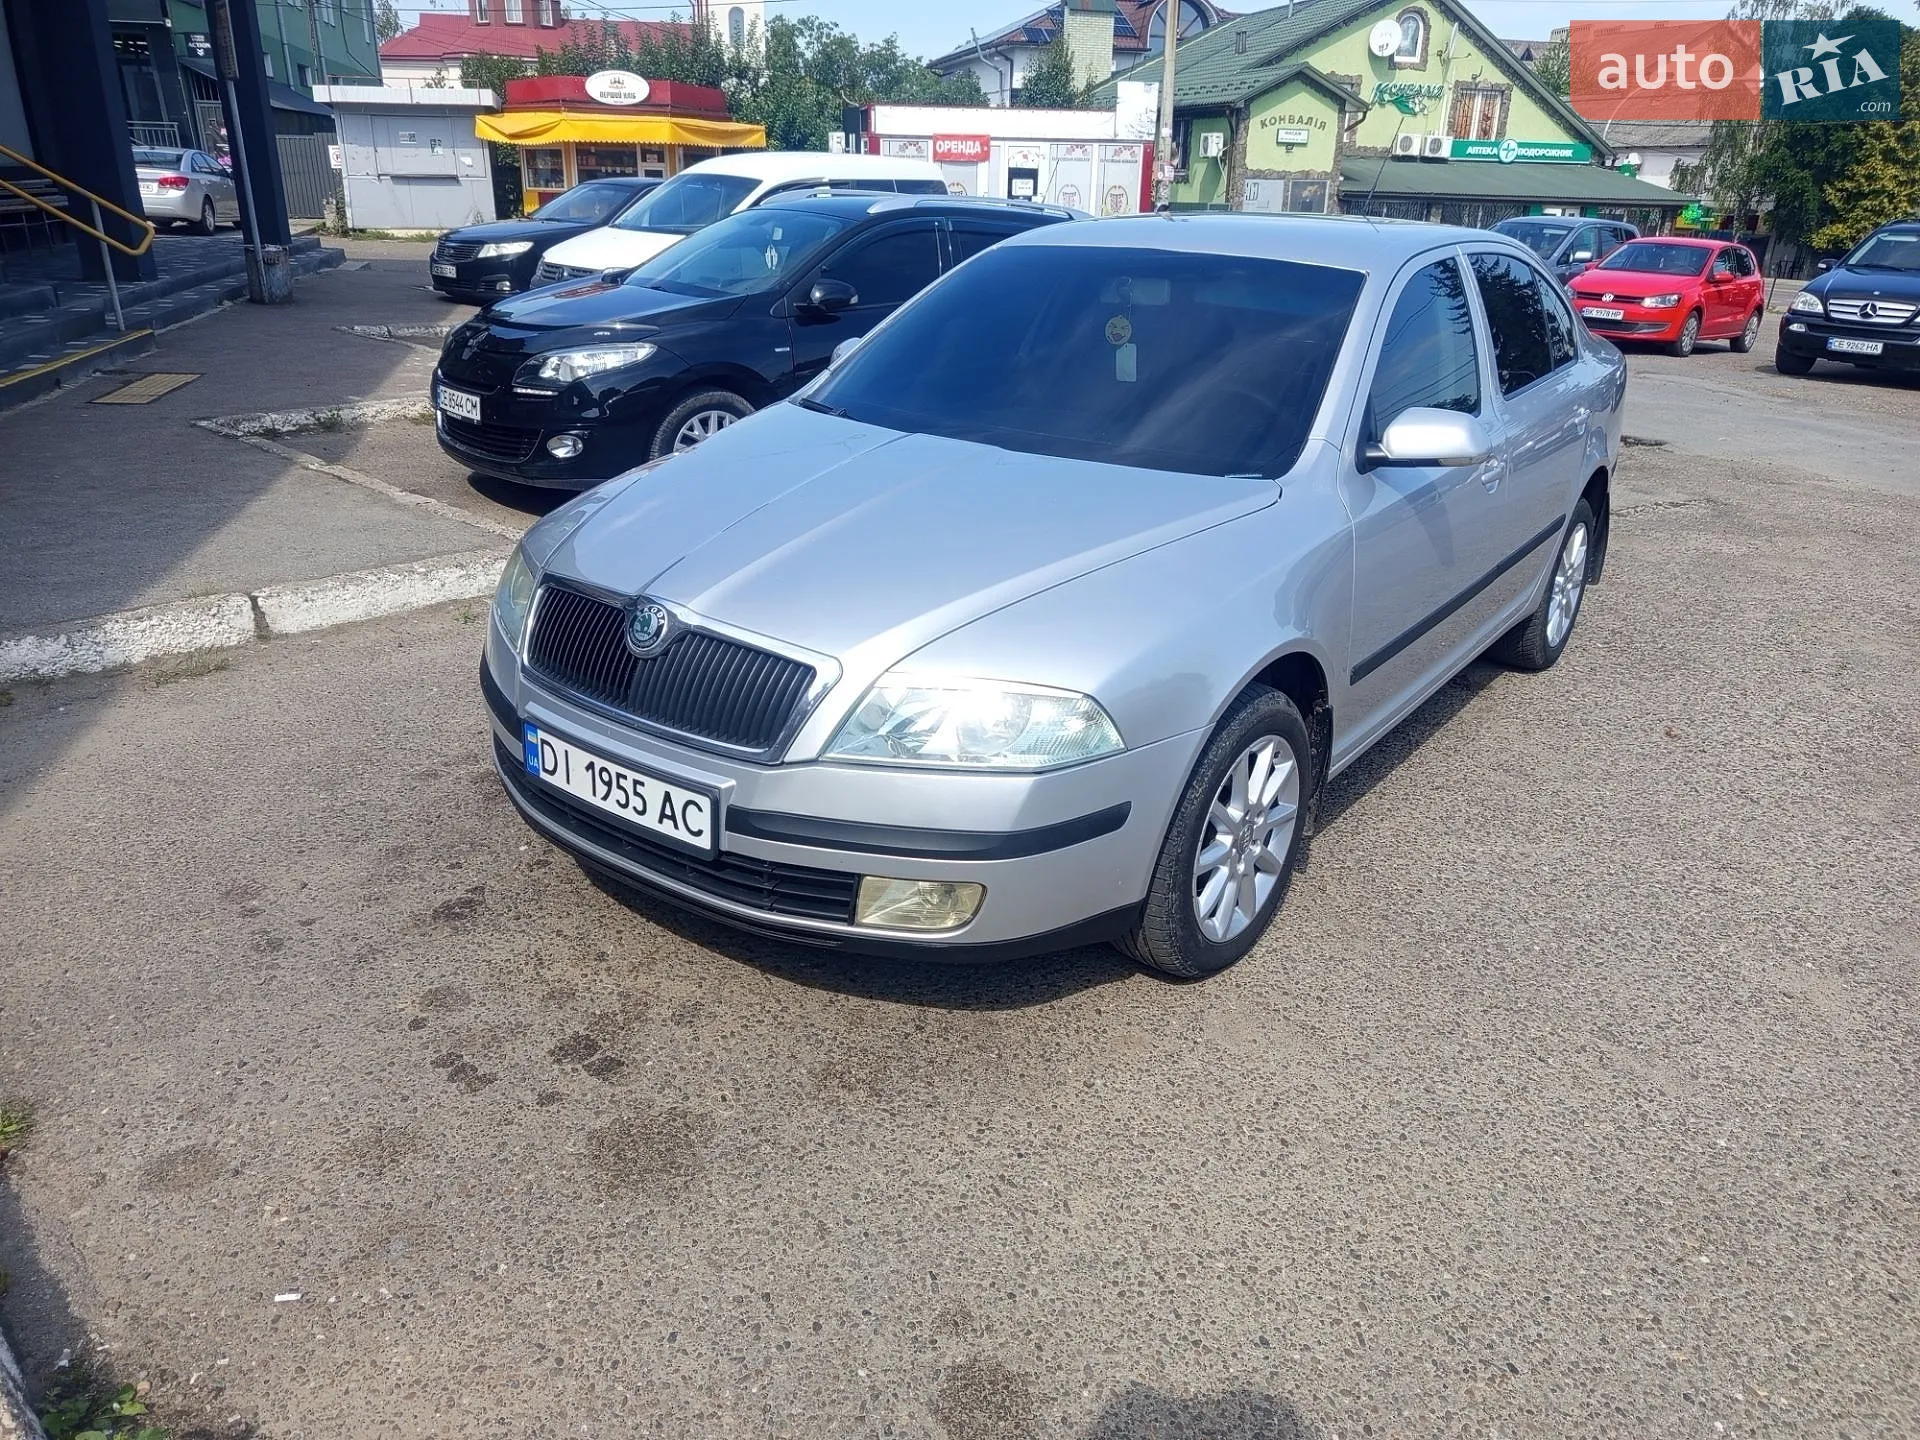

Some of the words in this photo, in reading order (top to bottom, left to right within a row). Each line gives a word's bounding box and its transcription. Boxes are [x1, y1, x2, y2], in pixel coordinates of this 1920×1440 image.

[1260, 114, 1327, 131] КОНВАЛІЯ
[935, 140, 981, 156] ОРЕНДА
[1466, 146, 1498, 155] АПТЕКА
[1517, 148, 1573, 158] ПОДОРОЖНИК
[1834, 340, 1845, 349] CE
[1866, 344, 1879, 352] HA
[466, 397, 478, 417] CM
[528, 754, 539, 769] UA
[540, 737, 570, 785] DI
[585, 760, 648, 817] 1955
[657, 790, 704, 838] AC
